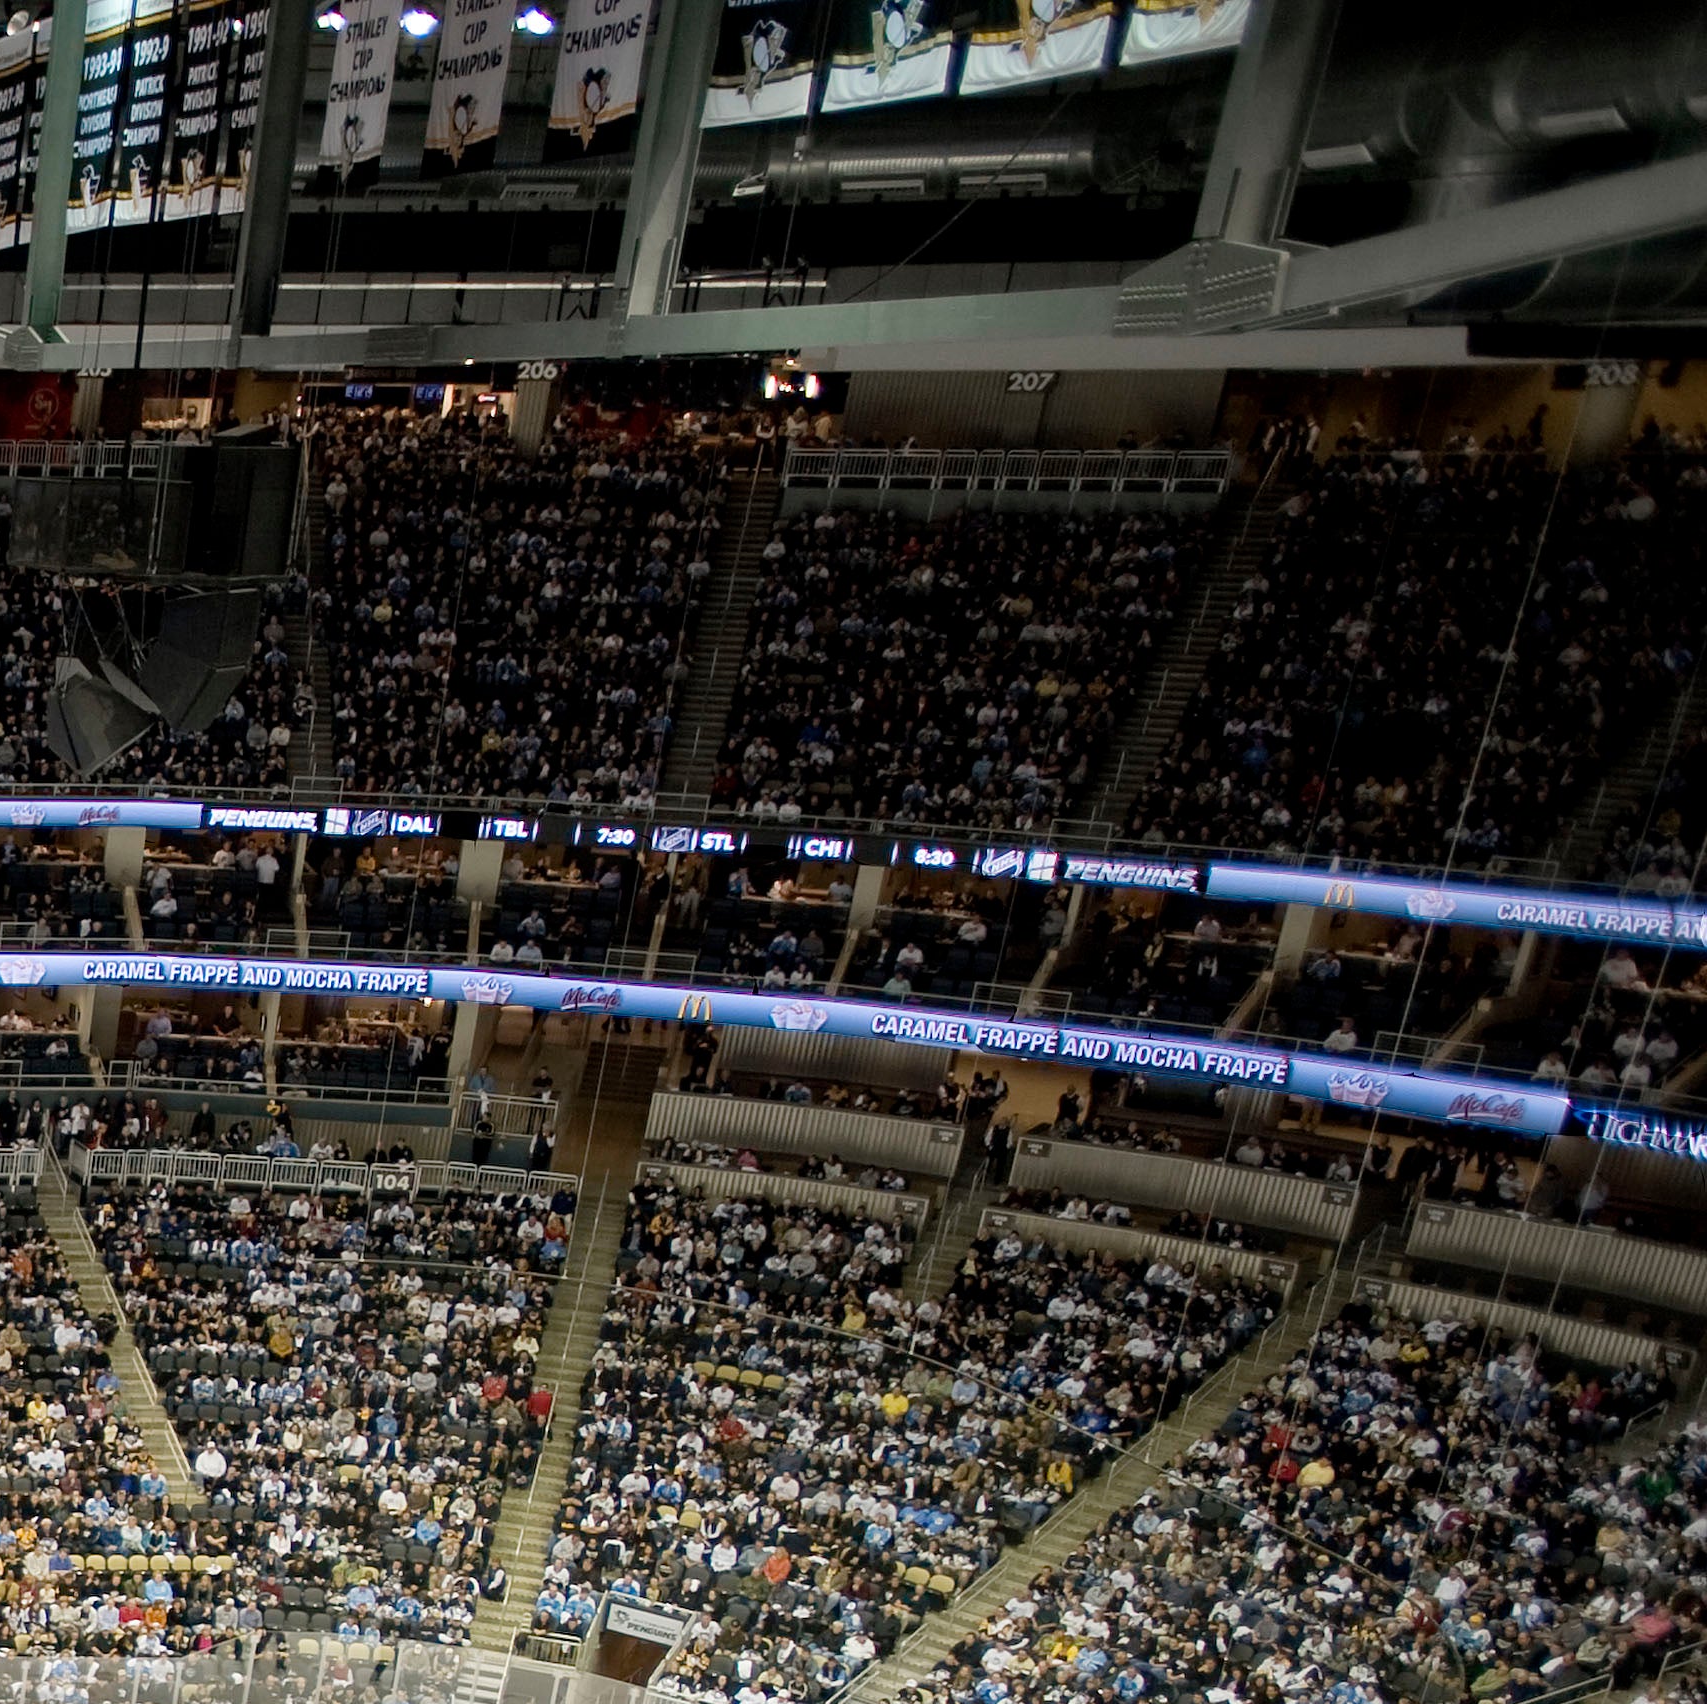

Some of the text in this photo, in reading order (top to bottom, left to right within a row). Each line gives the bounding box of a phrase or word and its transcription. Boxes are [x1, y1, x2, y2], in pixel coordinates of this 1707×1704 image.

[345, 16, 388, 46] STANLEY
[463, 21, 487, 46] CUP
[564, 14, 643, 56] CHAMPIONS
[352, 49, 374, 73] CUP
[437, 45, 503, 82] CHAMPIONS
[134, 74, 166, 99] PATRICK
[329, 73, 387, 106] CHAMPIONS
[80, 109, 112, 136] DIVISION
[130, 99, 163, 124] DIVISION
[517, 360, 559, 379] 206
[1007, 372, 1056, 392] 207
[396, 814, 435, 835] DAL
[492, 818, 529, 838] TBL
[597, 828, 636, 845] 7:30
[701, 832, 736, 851] STL
[805, 838, 843, 859] CHI
[913, 848, 956, 867] 8:30
[1496, 902, 1675, 938] CARAMEL FRAPPÉ
[82, 958, 429, 995] CARAMEL FRAPPÉ AND MOCHA FRAPPÉ
[871, 1013, 1290, 1085] CARAMEL FRAPPÉ AND MOCHA FRAPPÉ
[376, 1174, 410, 1190] 104
